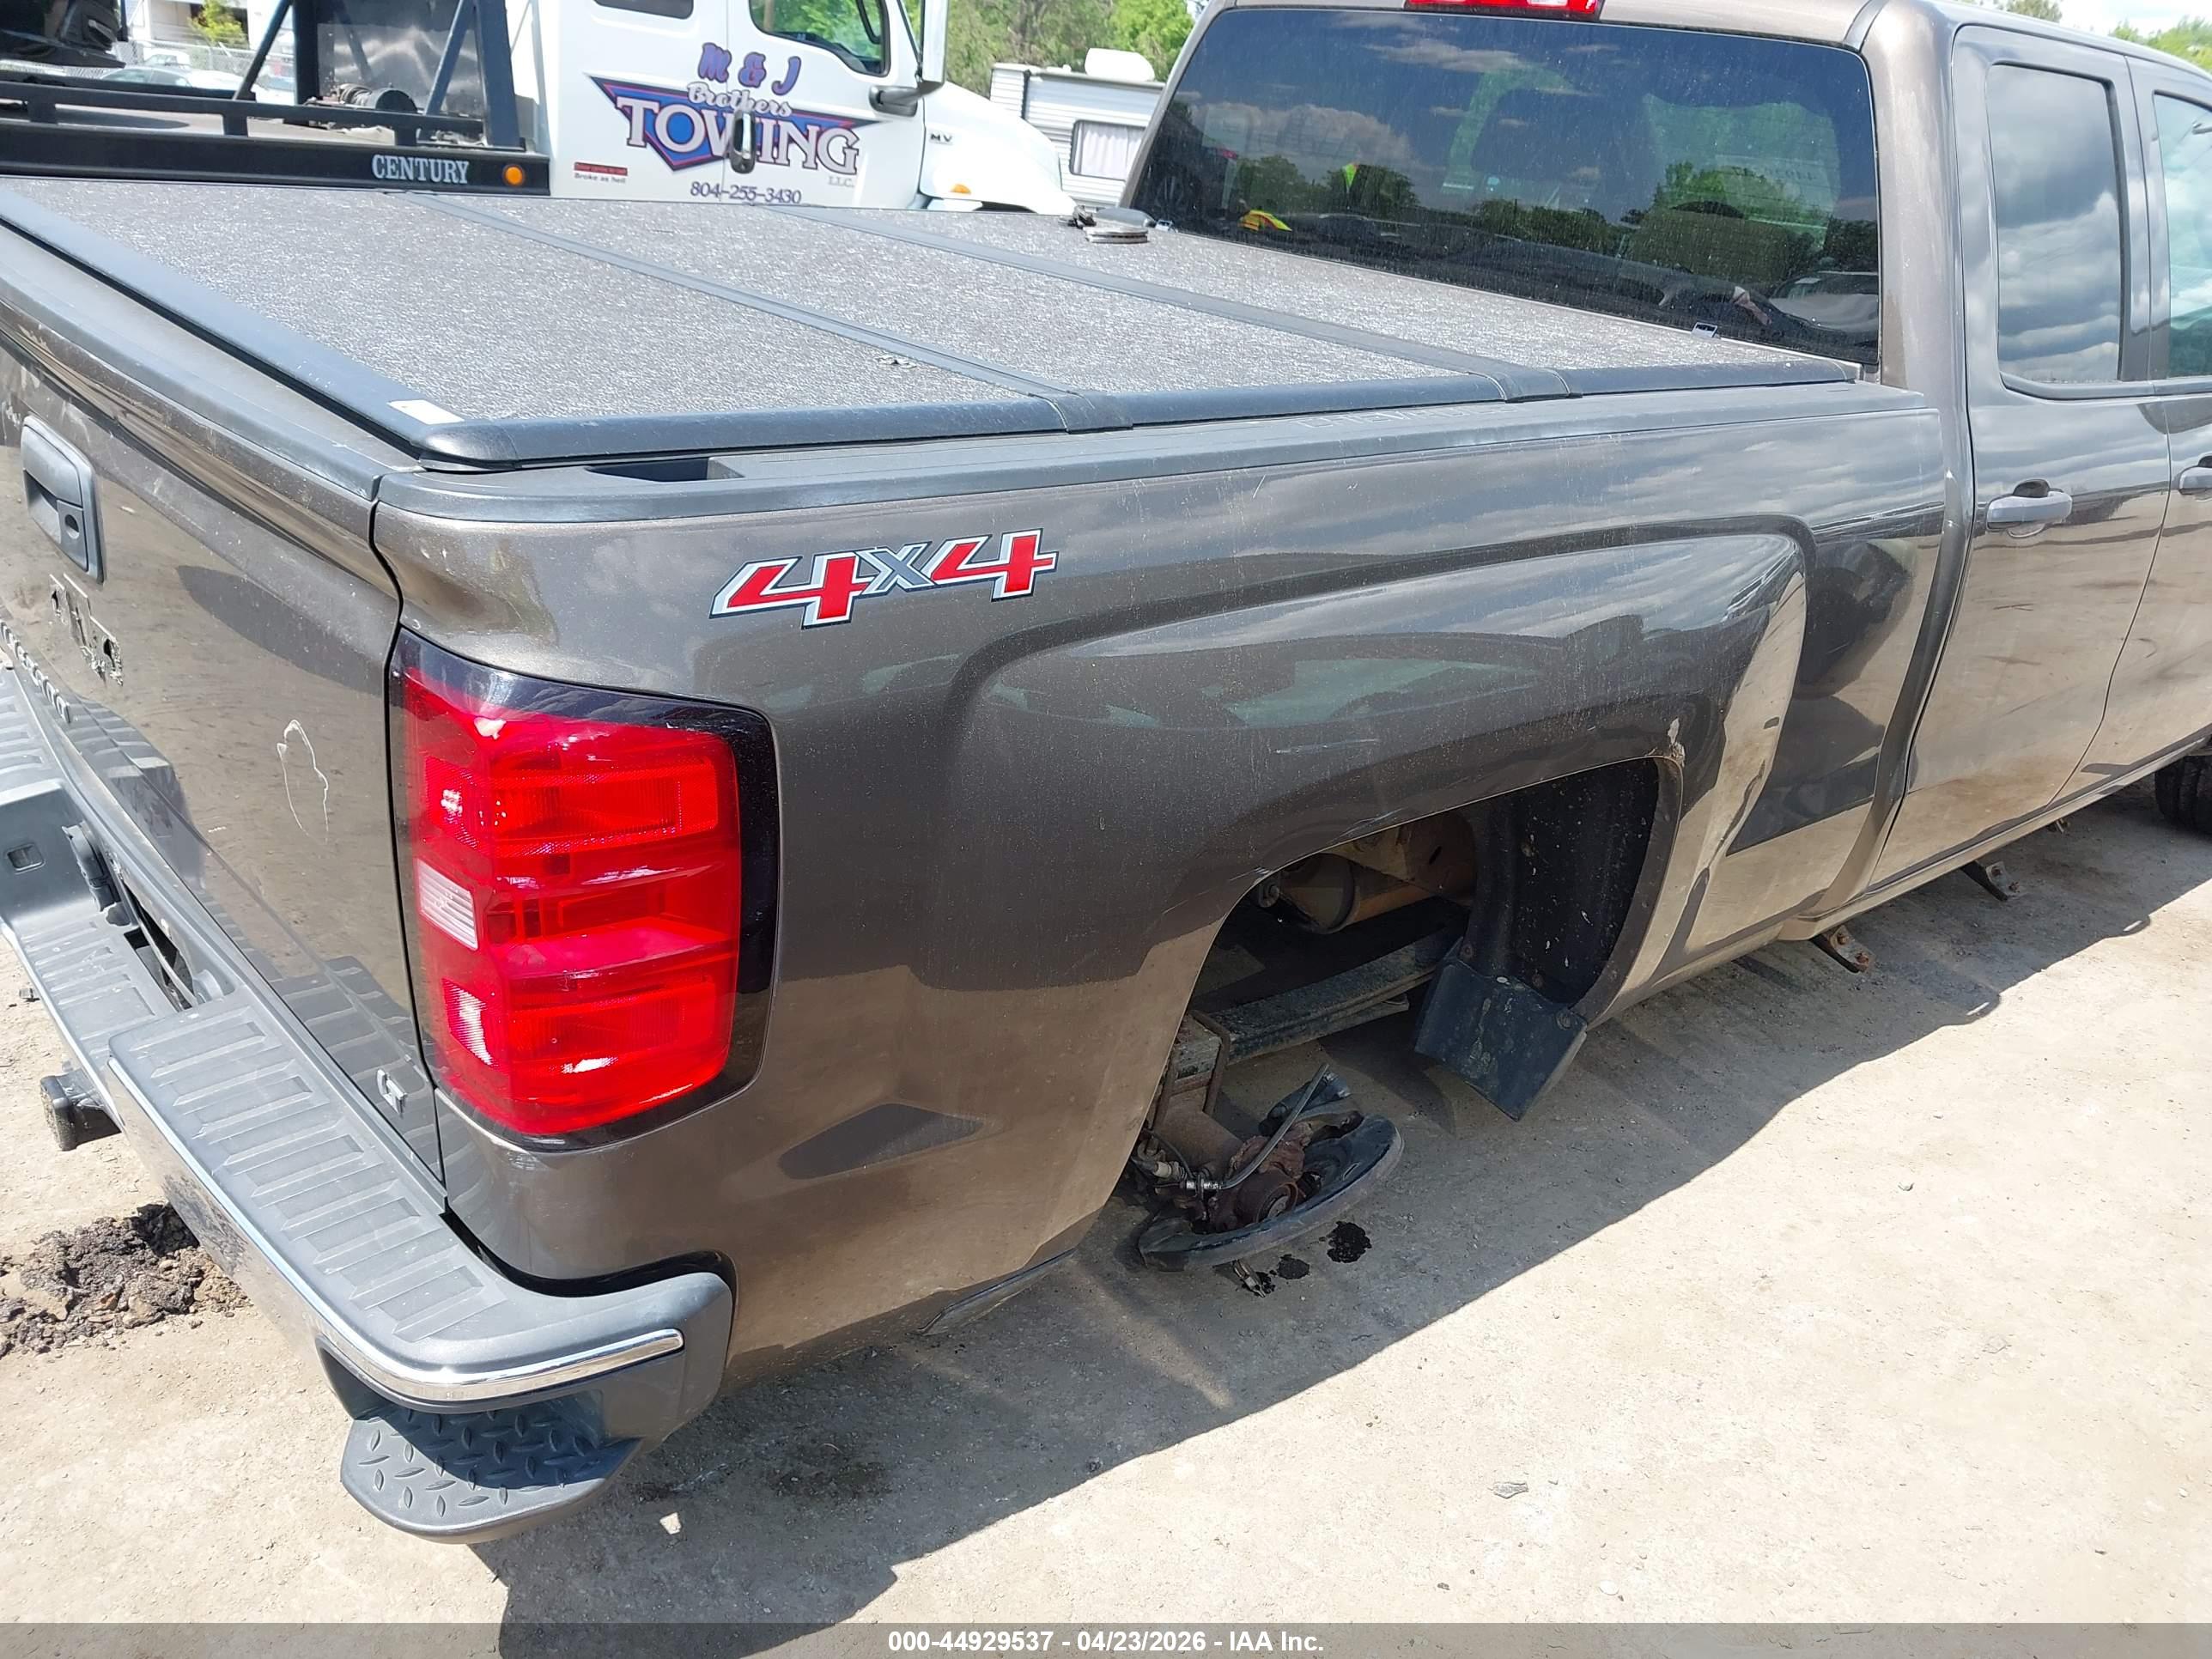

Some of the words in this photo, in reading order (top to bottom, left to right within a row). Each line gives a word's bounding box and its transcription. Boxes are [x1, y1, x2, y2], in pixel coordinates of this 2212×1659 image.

[697, 42, 732, 82] M
[738, 52, 766, 88] &
[772, 56, 801, 95] J
[687, 82, 792, 117] Brothers
[930, 133, 953, 143] MV
[372, 155, 470, 184] CENTURY
[690, 182, 802, 204] 804-255-3430
